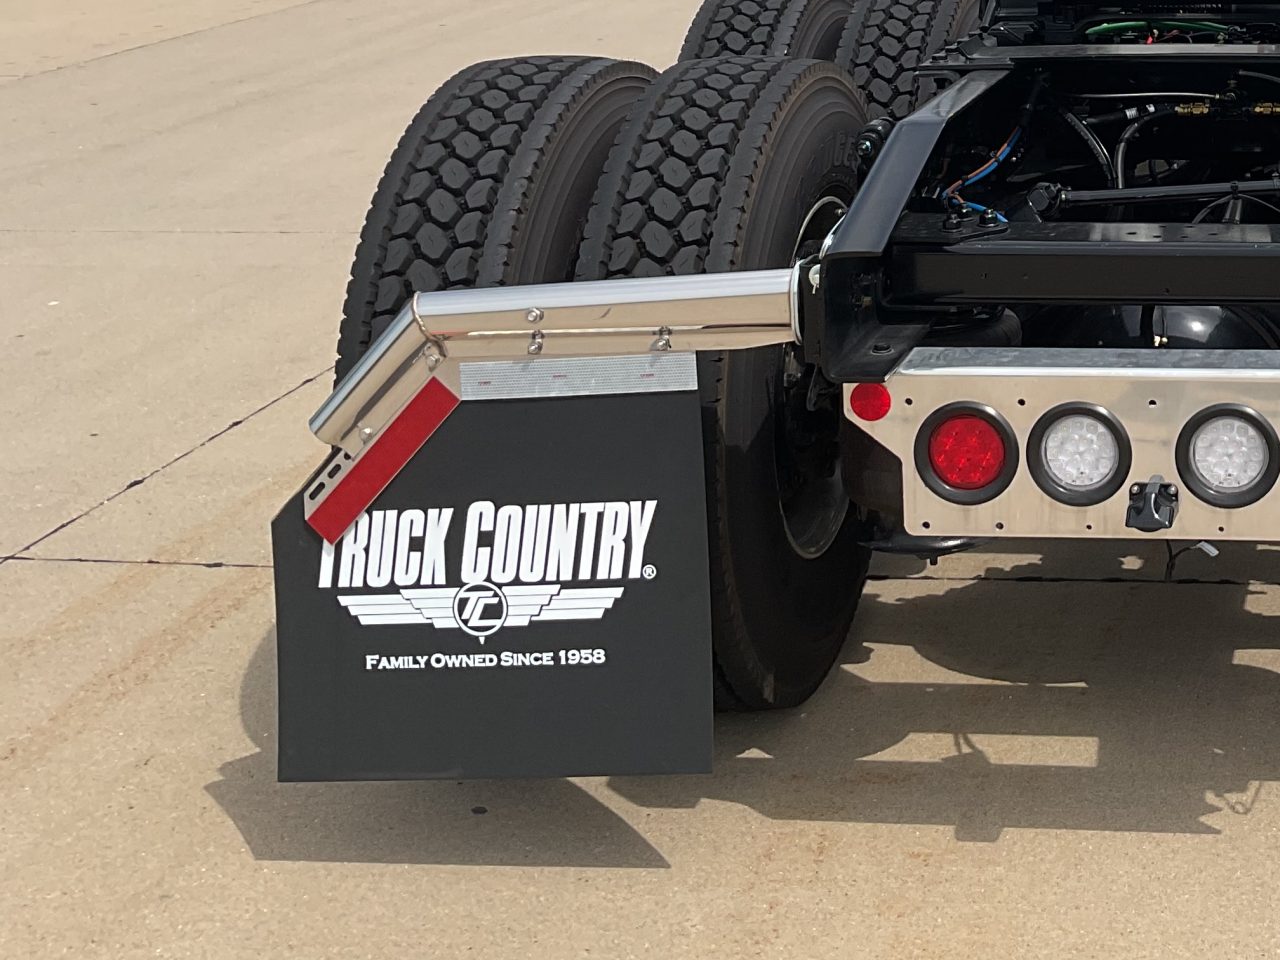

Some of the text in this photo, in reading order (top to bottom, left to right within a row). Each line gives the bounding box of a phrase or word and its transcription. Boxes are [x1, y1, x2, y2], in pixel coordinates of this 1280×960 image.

[461, 500, 657, 584] COUNTRY
[365, 648, 606, 670] FAMILY OWNED SINCE 1958
